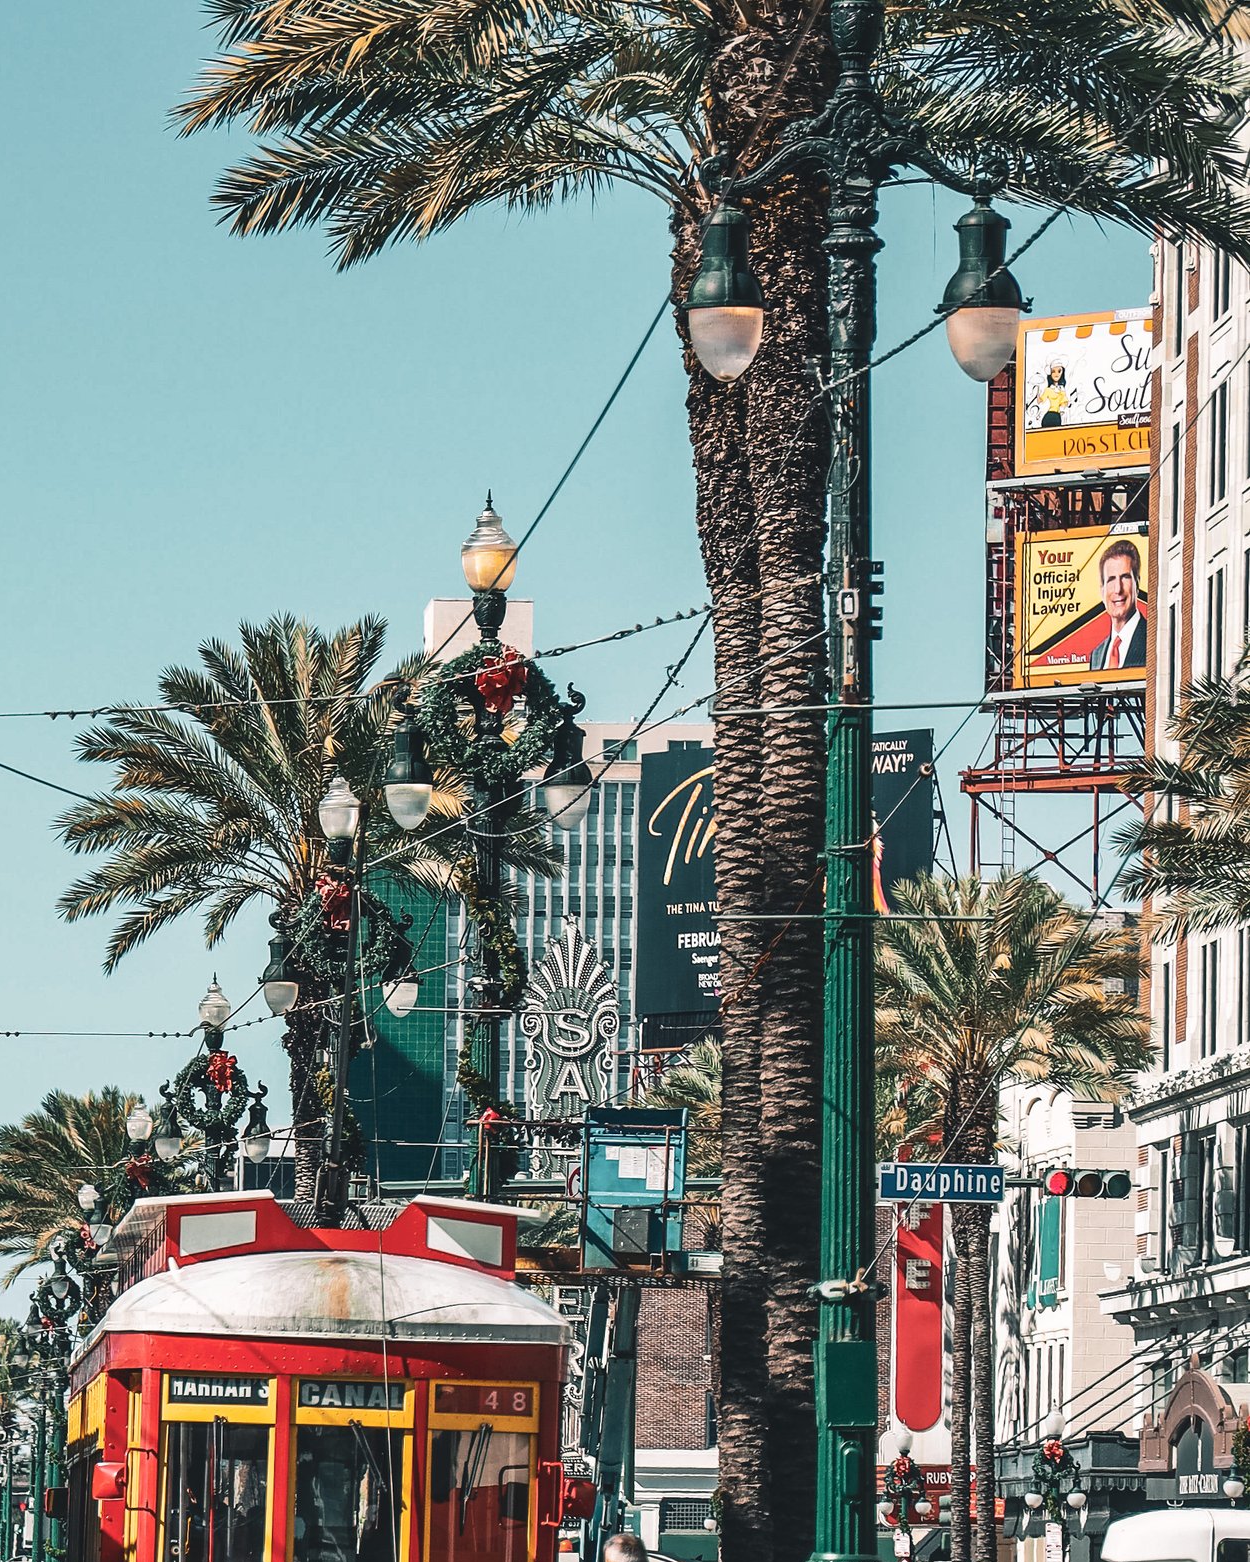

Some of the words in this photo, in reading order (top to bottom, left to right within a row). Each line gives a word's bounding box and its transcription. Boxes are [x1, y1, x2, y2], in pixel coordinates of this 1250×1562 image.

[1111, 334, 1151, 373] Su
[1085, 371, 1152, 414] Soul
[1063, 436, 1096, 456] 1205
[1037, 549, 1074, 565] Your
[1033, 570, 1081, 585] Official
[1037, 586, 1076, 601] Injury
[1032, 602, 1081, 617] Lawyer
[1047, 655, 1071, 664] Morris
[1071, 653, 1087, 663] Bart
[666, 902, 683, 915] THE
[686, 901, 706, 914] TINA
[896, 1168, 1000, 1198] Dauphine
[300, 1382, 405, 1409] CANAL
[926, 1472, 952, 1485] RUBY
